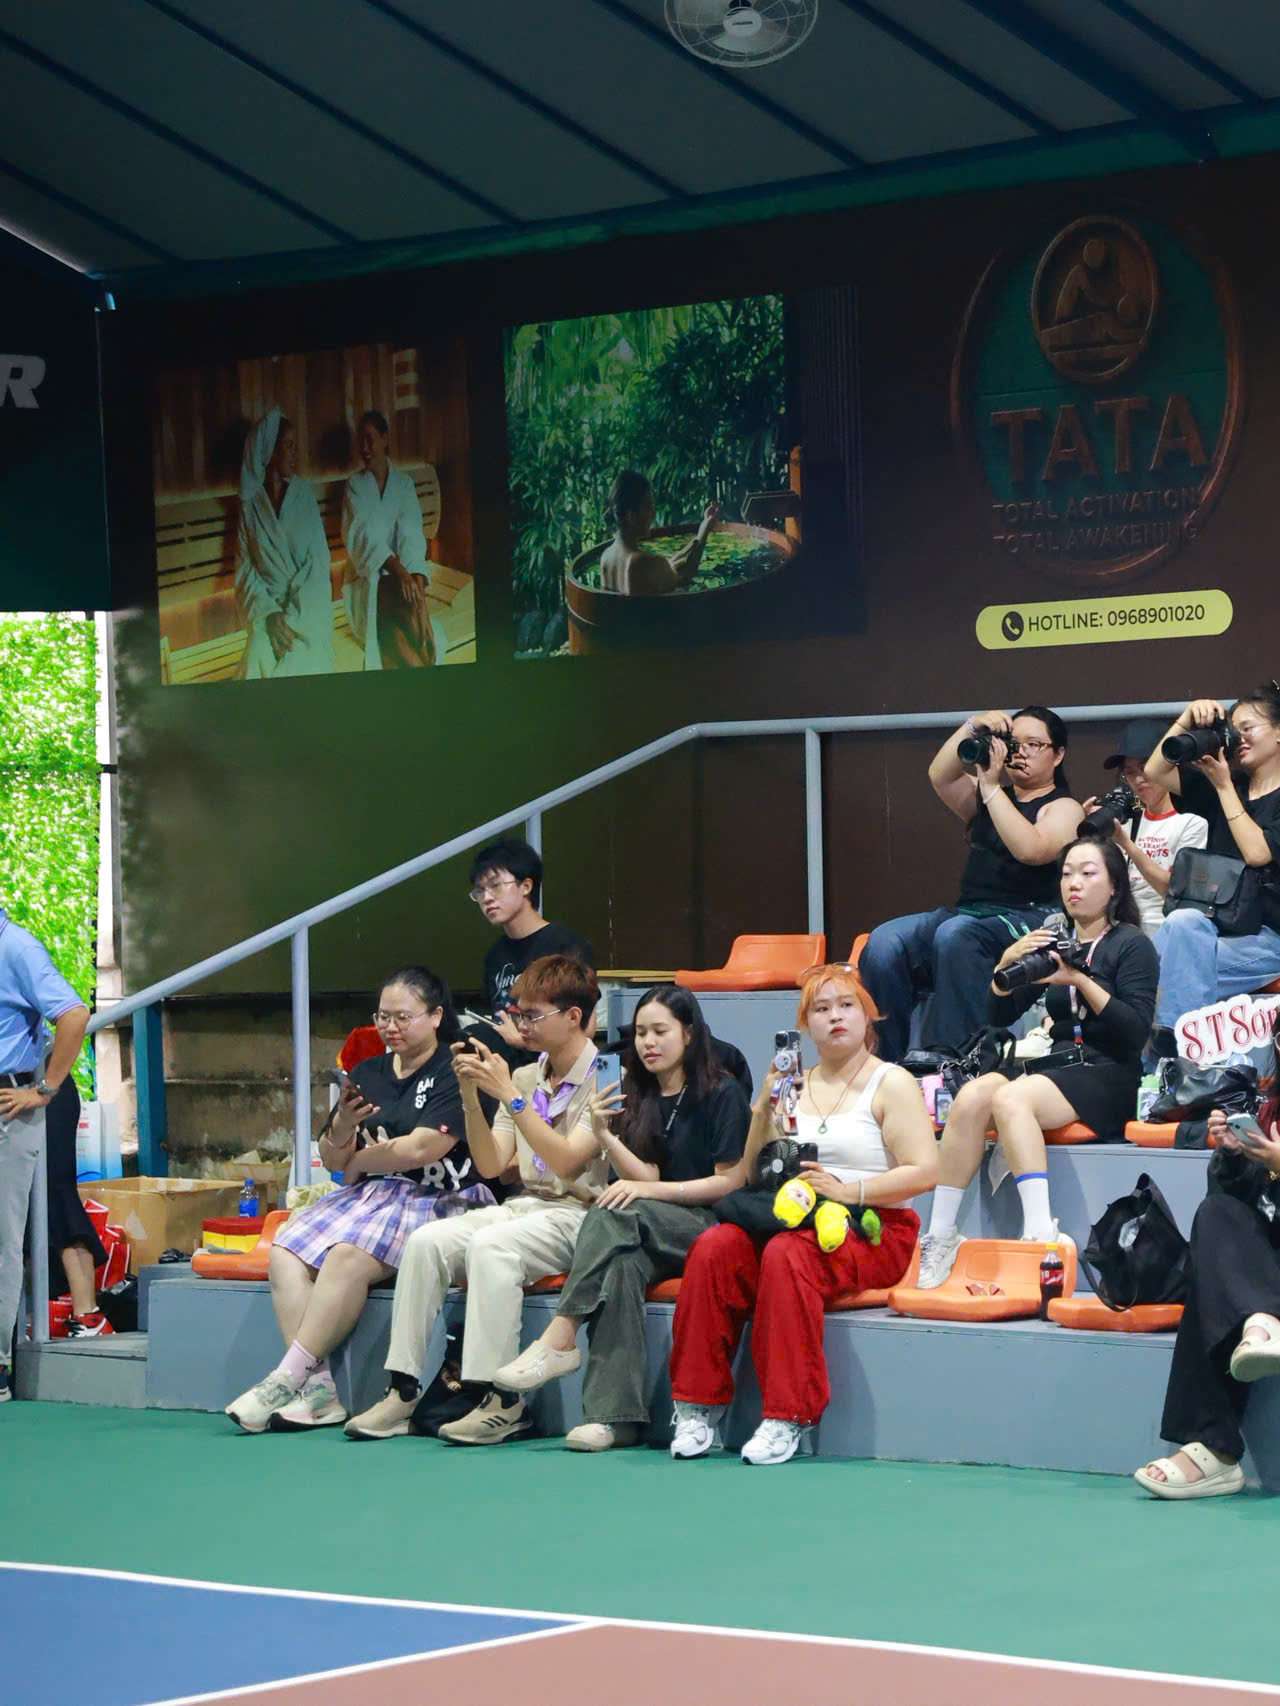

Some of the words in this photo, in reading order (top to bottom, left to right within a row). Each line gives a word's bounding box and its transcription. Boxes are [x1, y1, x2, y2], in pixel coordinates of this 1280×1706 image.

[990, 393, 1208, 484] TATA
[992, 500, 1058, 523] TOTAL
[1066, 487, 1203, 517] ACTIVATION
[992, 532, 1059, 553] TOTAL
[1028, 612, 1103, 632] HOTLINE:
[1107, 604, 1205, 626] 0968901020
